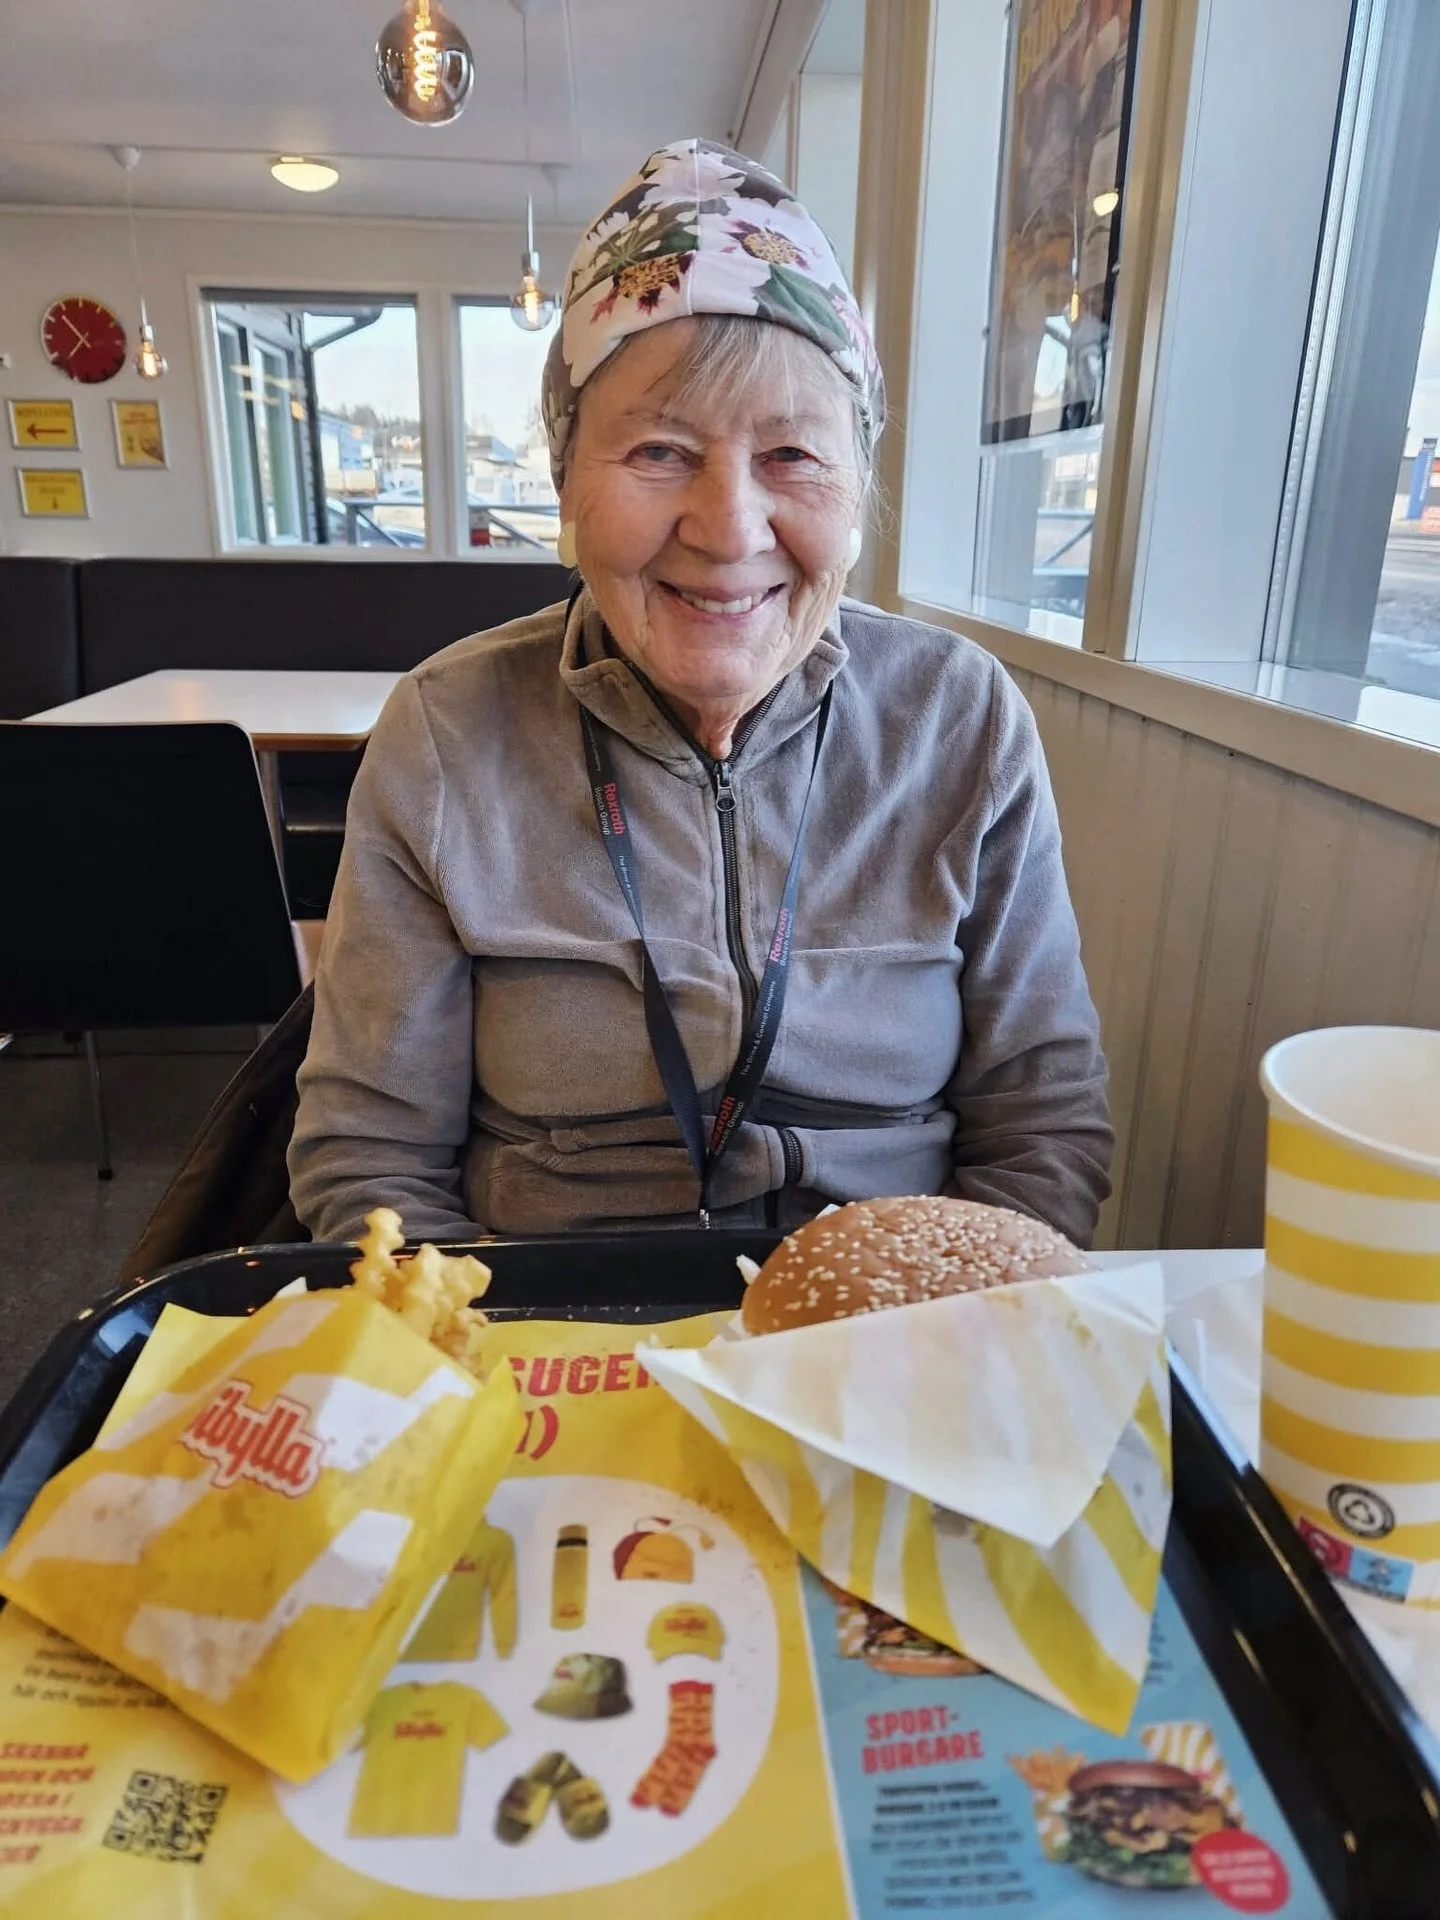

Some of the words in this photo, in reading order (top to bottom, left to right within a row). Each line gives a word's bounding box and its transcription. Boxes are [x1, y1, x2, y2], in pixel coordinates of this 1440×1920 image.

[593, 785, 605, 811] Bosch
[600, 811, 611, 835] Group
[602, 782, 625, 835] Rexroth
[769, 906, 789, 962] Rexroth
[779, 937, 791, 967] Bosch
[740, 1066, 749, 1076] The
[747, 1046, 758, 1066] Drive
[756, 1013, 768, 1039] Control
[764, 980, 776, 1012] Company
[727, 1101, 744, 1128] Group
[186, 1387, 313, 1487] ibylla
[864, 1703, 959, 1740] SPORT-
[861, 1728, 984, 1775] BURGARE
